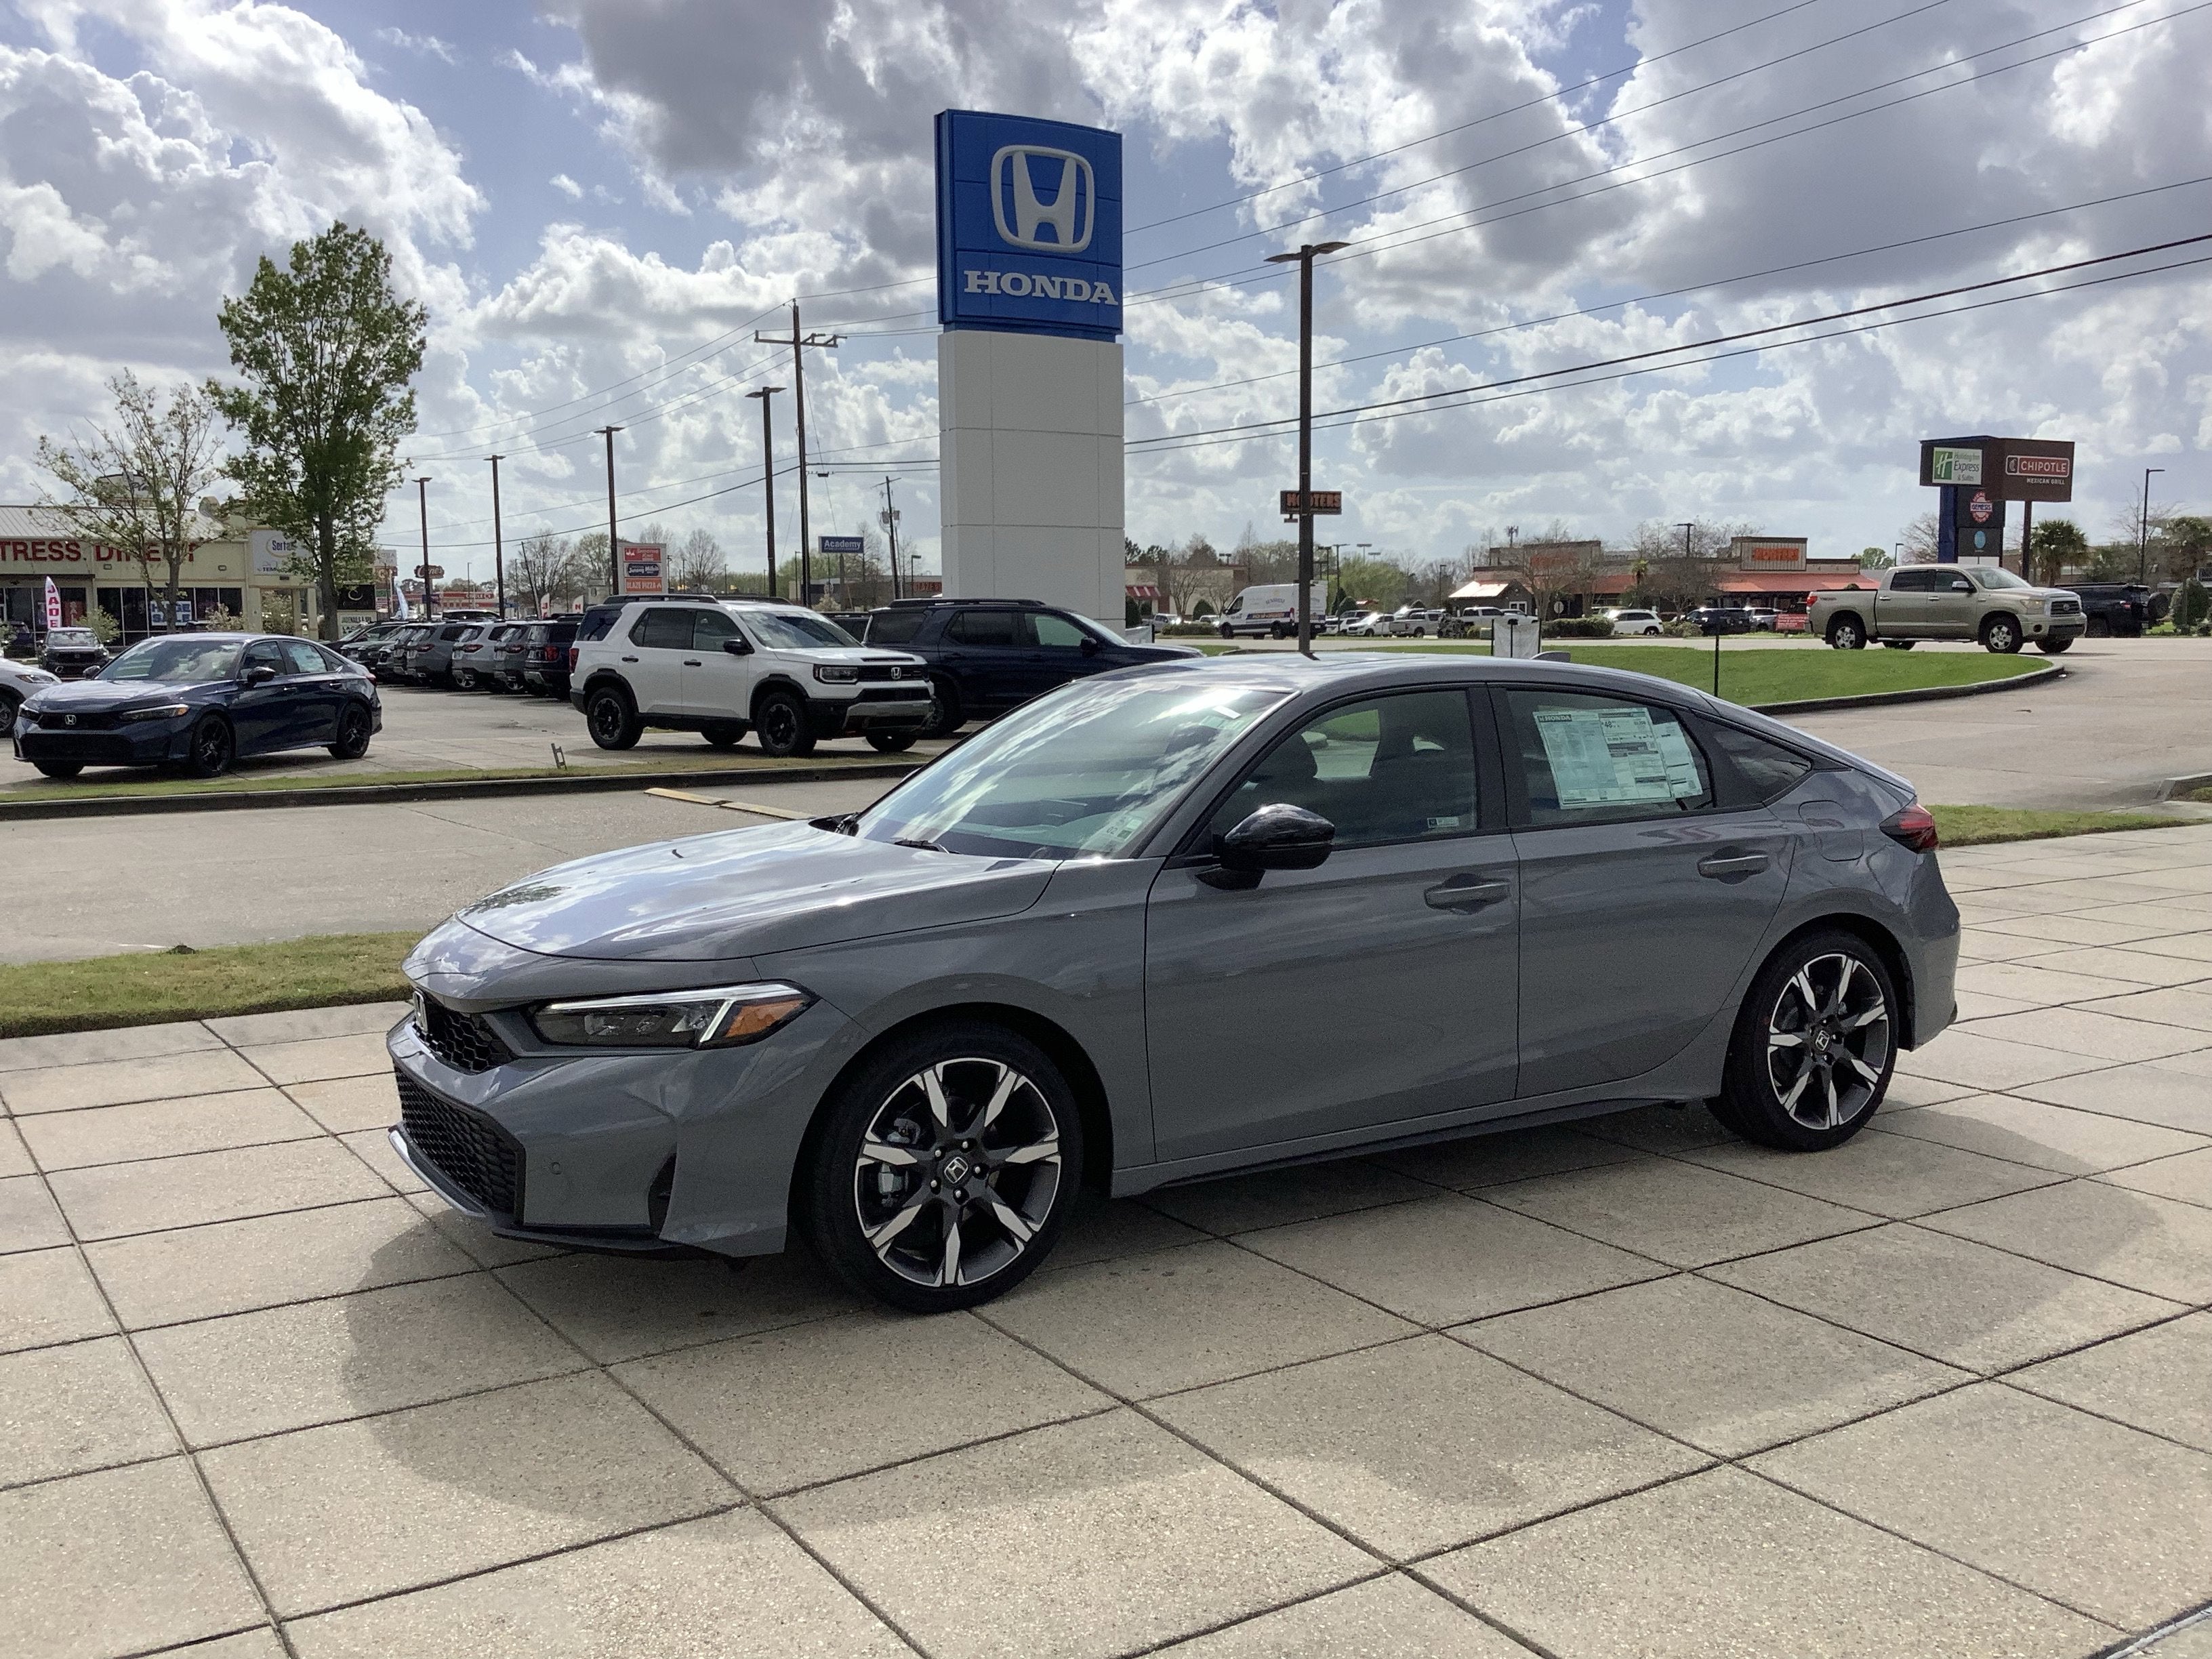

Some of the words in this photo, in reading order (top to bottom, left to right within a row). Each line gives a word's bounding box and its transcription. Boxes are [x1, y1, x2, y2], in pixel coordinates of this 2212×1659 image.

[964, 270, 1119, 306] HONDA
[1954, 460, 1980, 473] Express
[2020, 460, 2067, 472] CHIPOTLE
[824, 539, 861, 550] Academy
